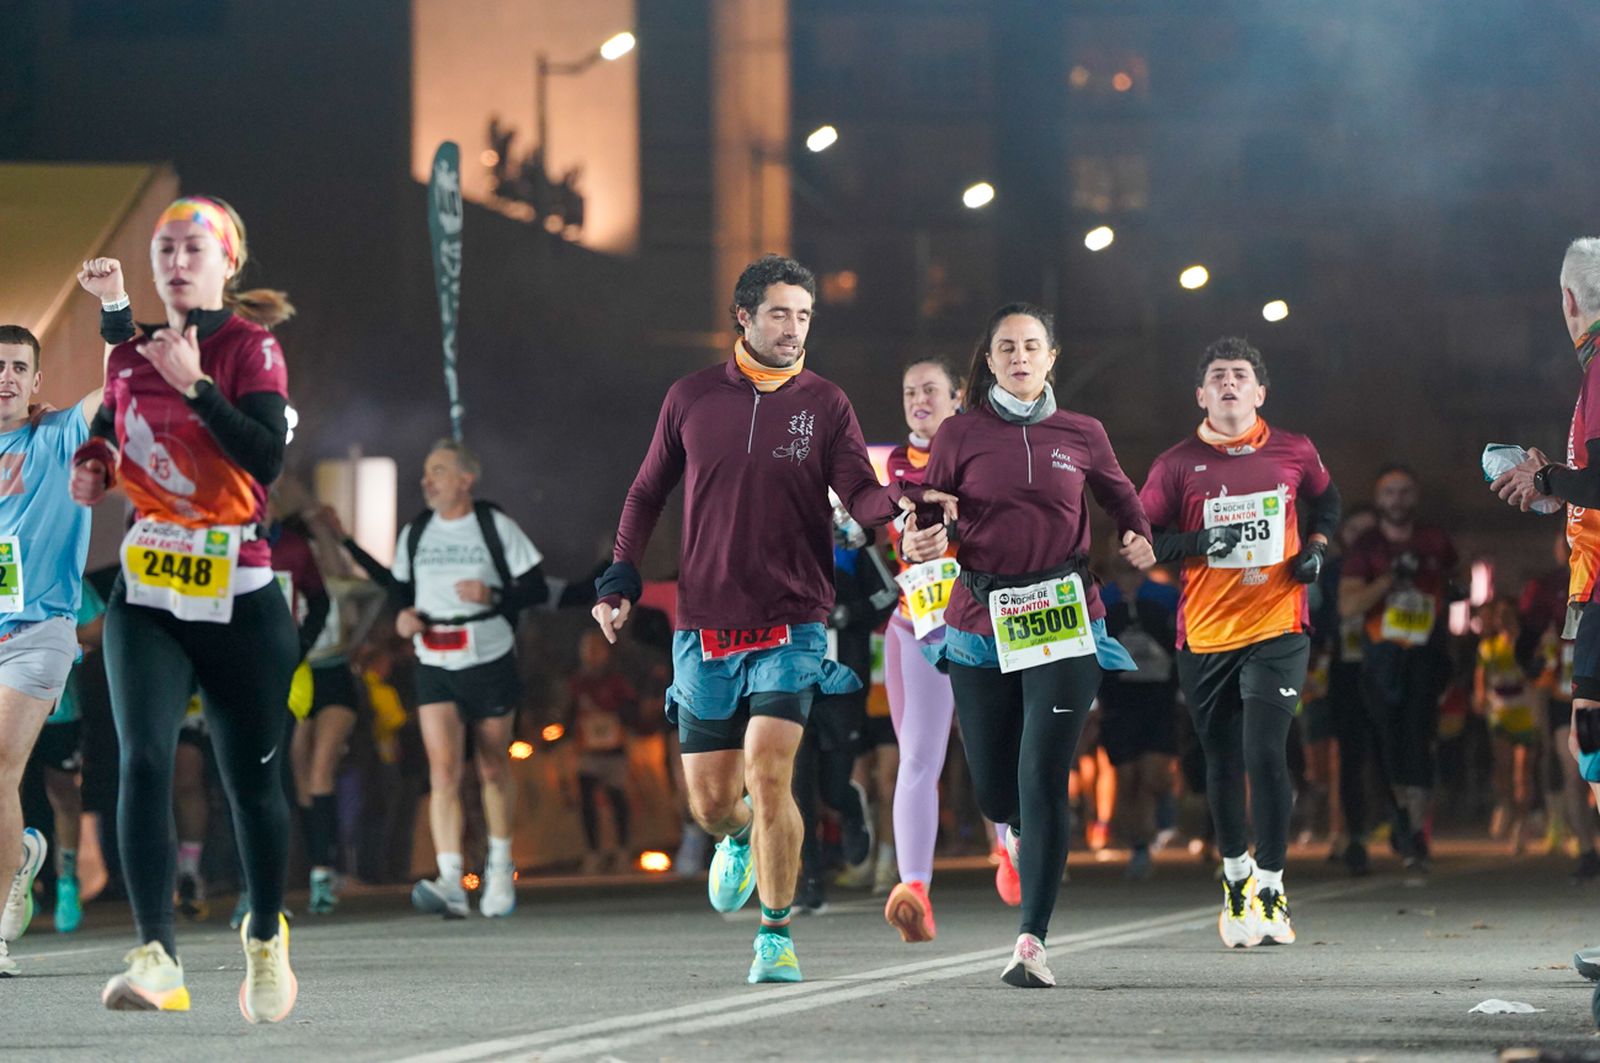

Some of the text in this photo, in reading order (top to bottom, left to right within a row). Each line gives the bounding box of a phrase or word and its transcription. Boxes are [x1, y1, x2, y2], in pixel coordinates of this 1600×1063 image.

[148, 452, 171, 480] 43
[1223, 503, 1245, 512] NOCHE
[1214, 513, 1230, 523] SAN
[137, 536, 156, 547] SAN
[143, 550, 212, 587] 2448
[1010, 591, 1036, 605] NOCHE
[1037, 590, 1048, 599] DE
[1000, 607, 1019, 616] SAN
[1003, 605, 1078, 642] 13500
